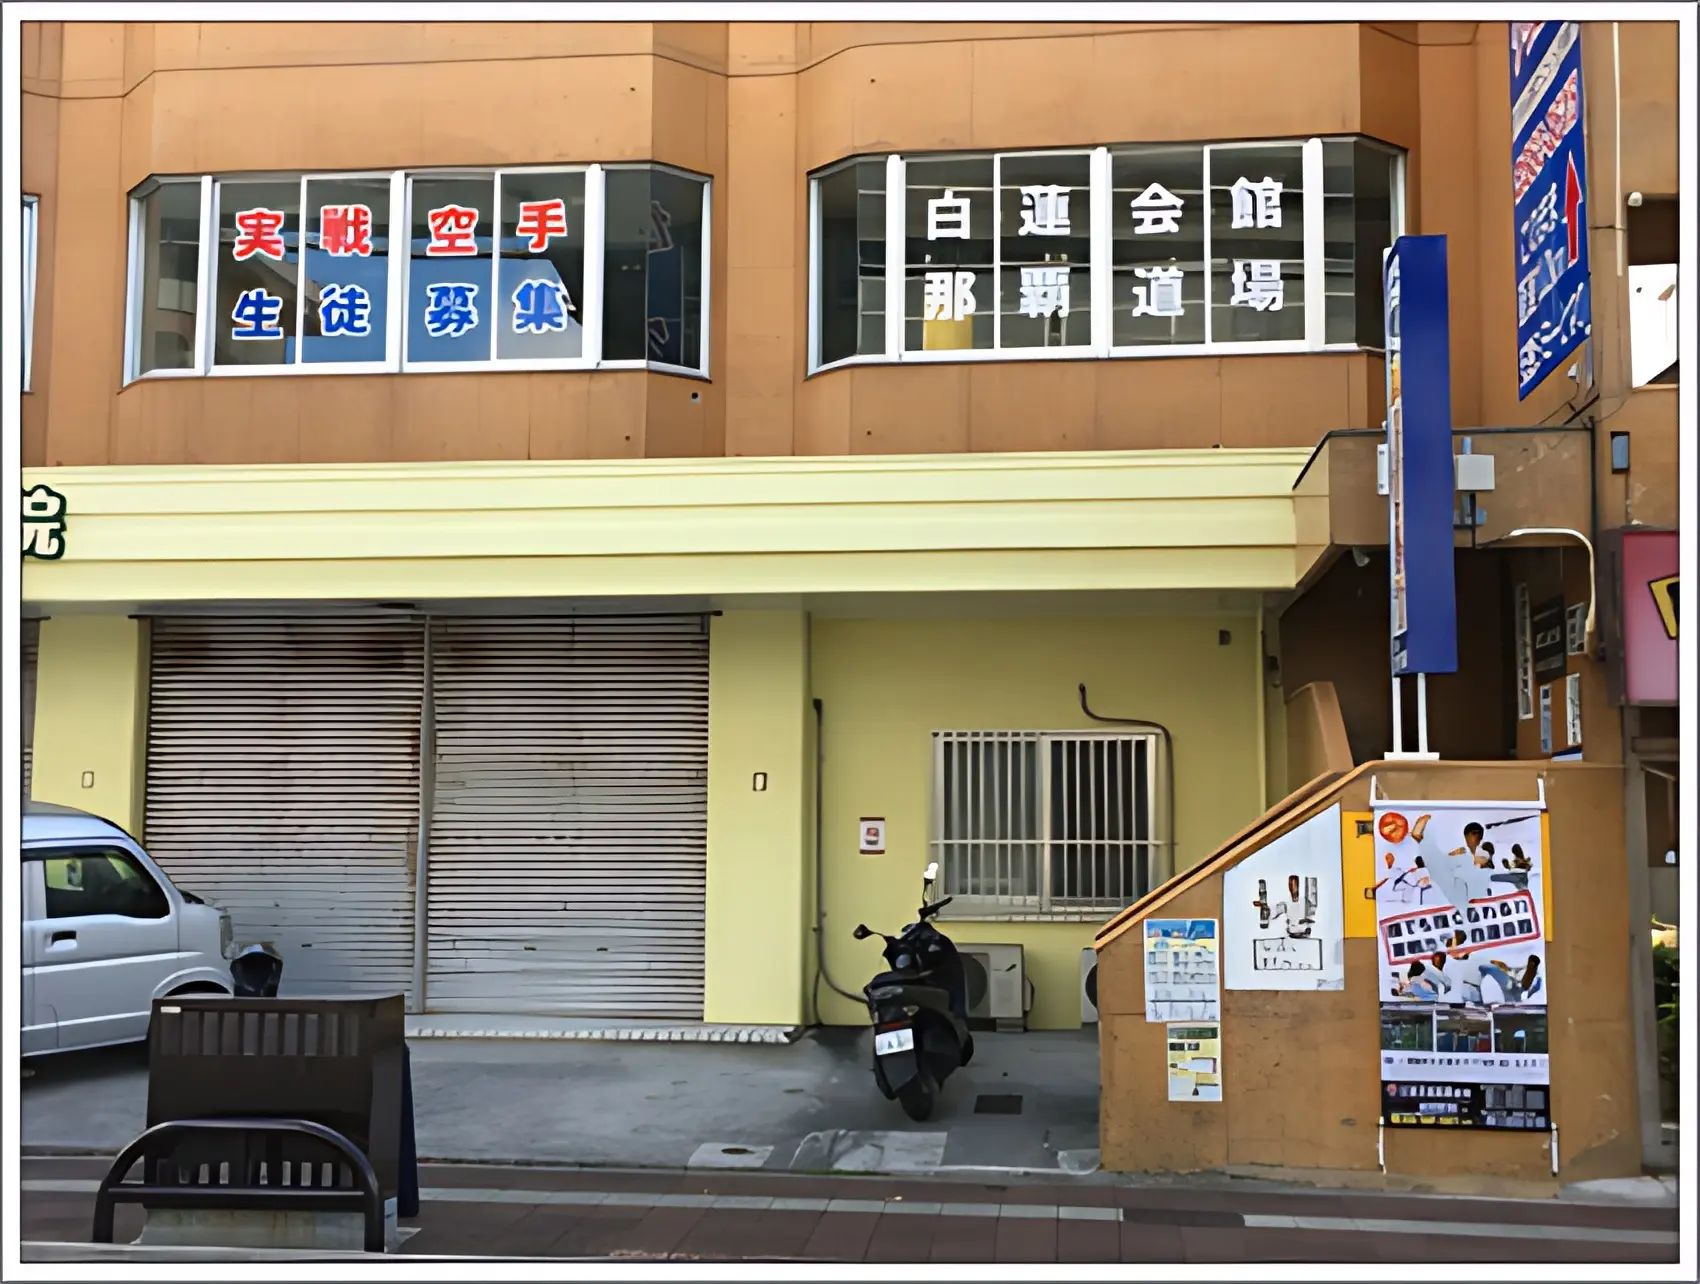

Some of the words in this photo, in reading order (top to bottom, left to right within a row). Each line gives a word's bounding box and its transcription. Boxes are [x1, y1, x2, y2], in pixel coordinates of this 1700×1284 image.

[233, 198, 567, 262] 実戦空手
[926, 176, 1284, 241] 白蓮会館
[231, 279, 567, 340] 生徒募集
[924, 258, 1284, 321] 那覇道場
